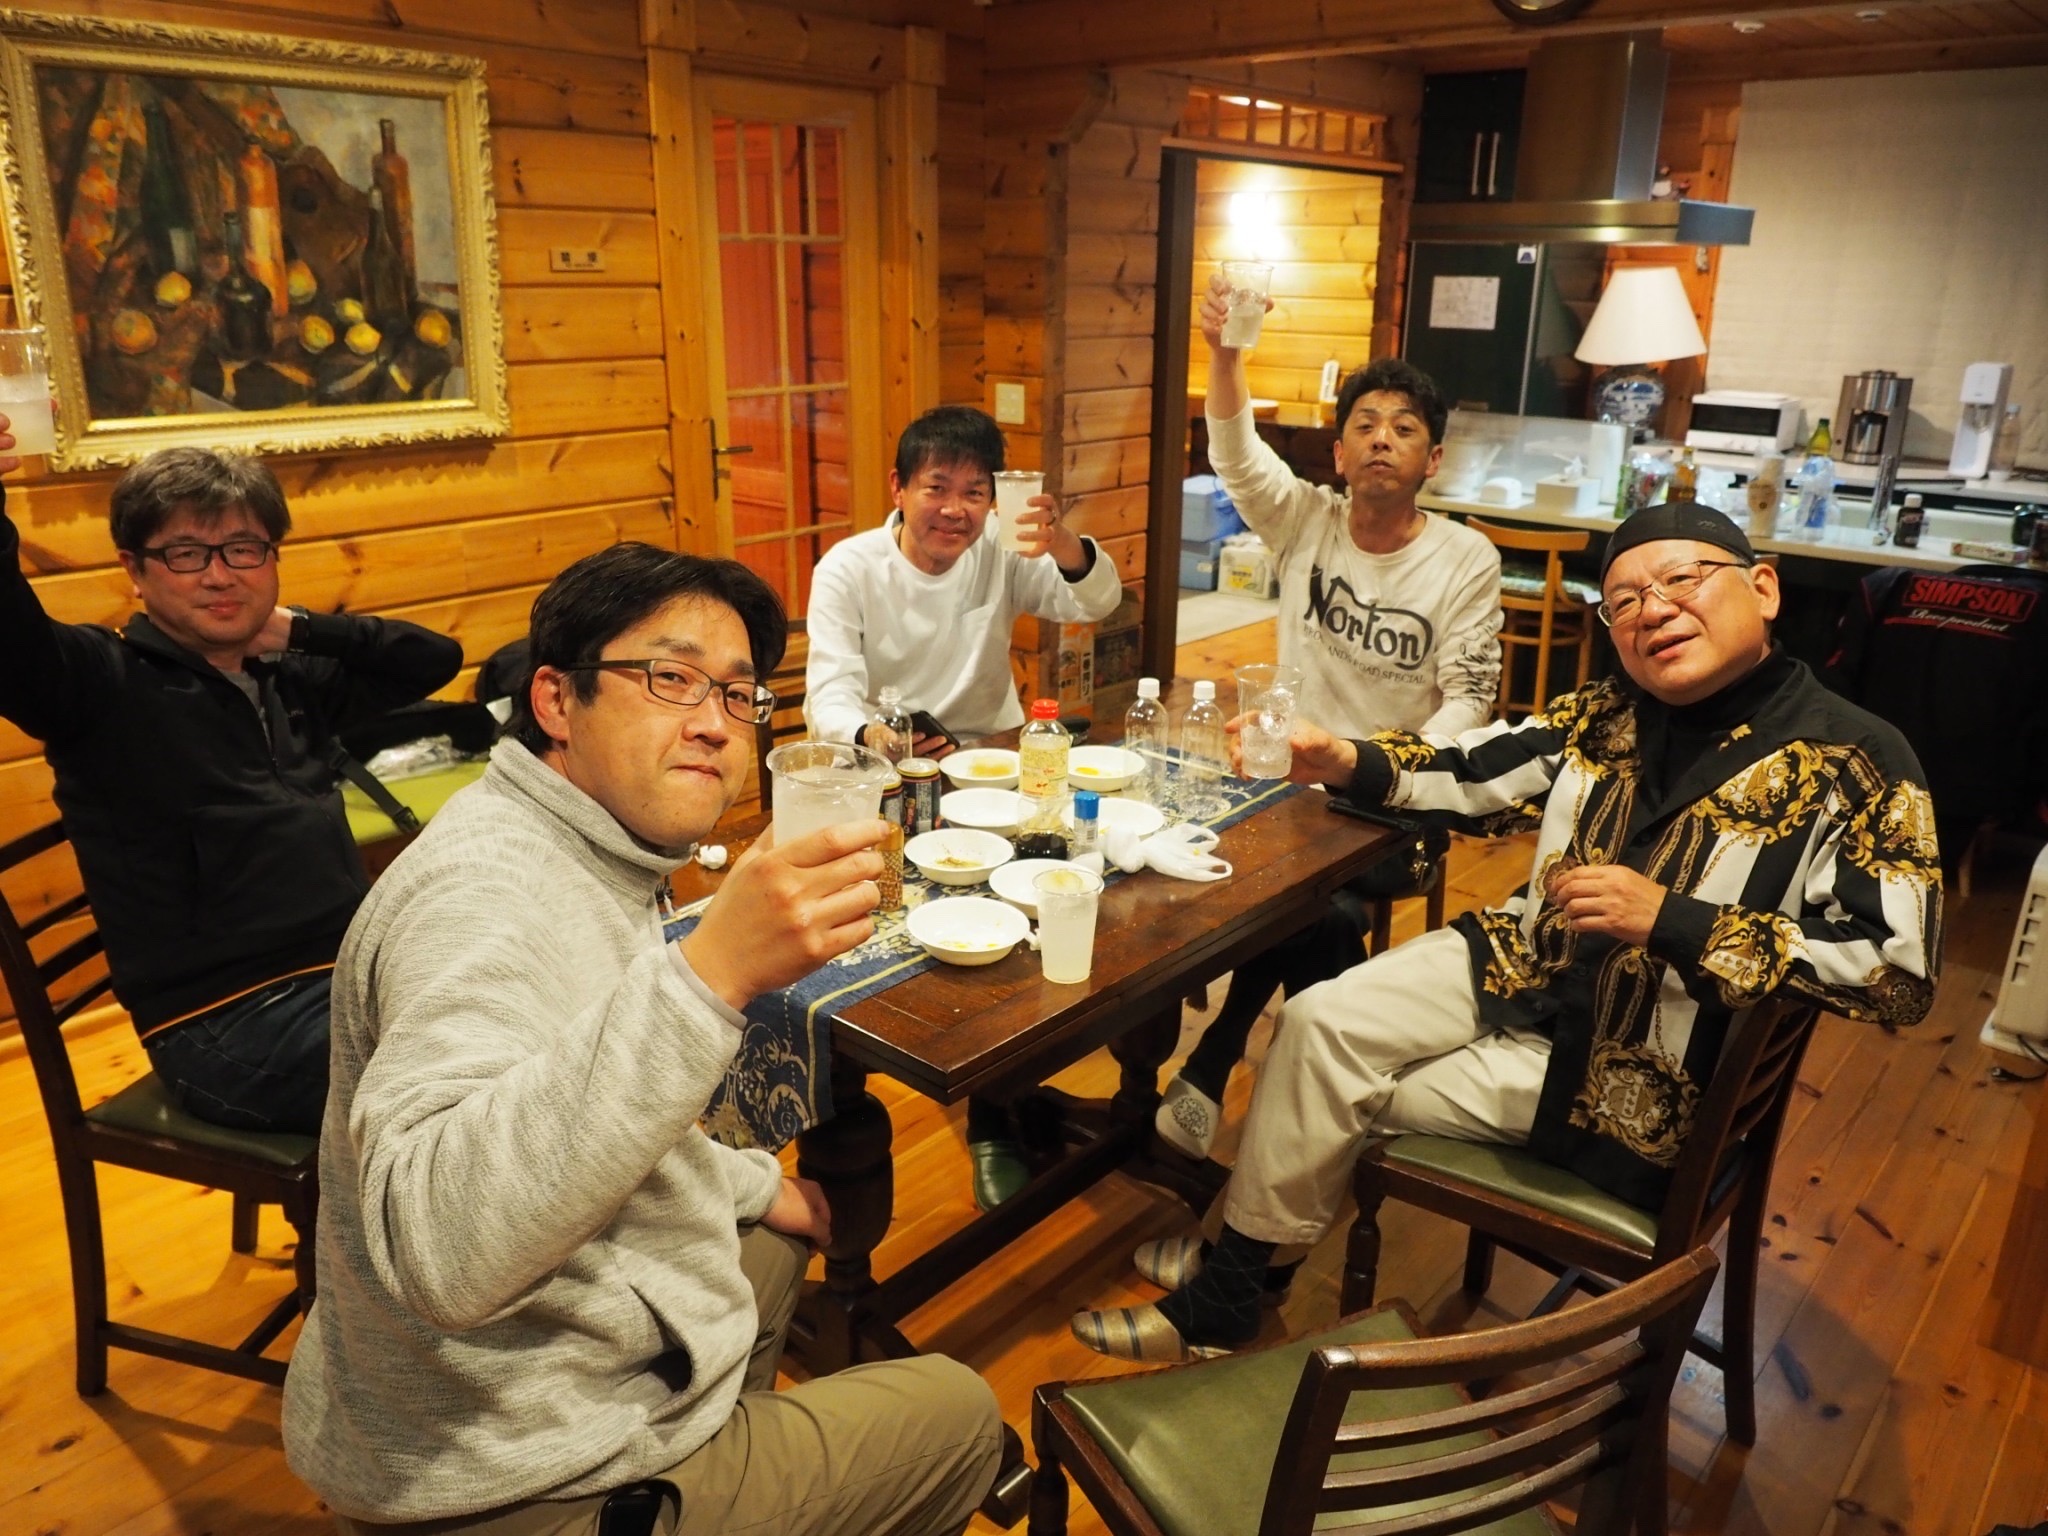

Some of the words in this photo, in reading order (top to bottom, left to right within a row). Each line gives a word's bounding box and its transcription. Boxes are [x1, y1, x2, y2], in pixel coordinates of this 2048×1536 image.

[1911, 580, 2025, 616] SIMPSON
[1304, 564, 1431, 669] Norton
[1382, 671, 1426, 684] SPECIAL
